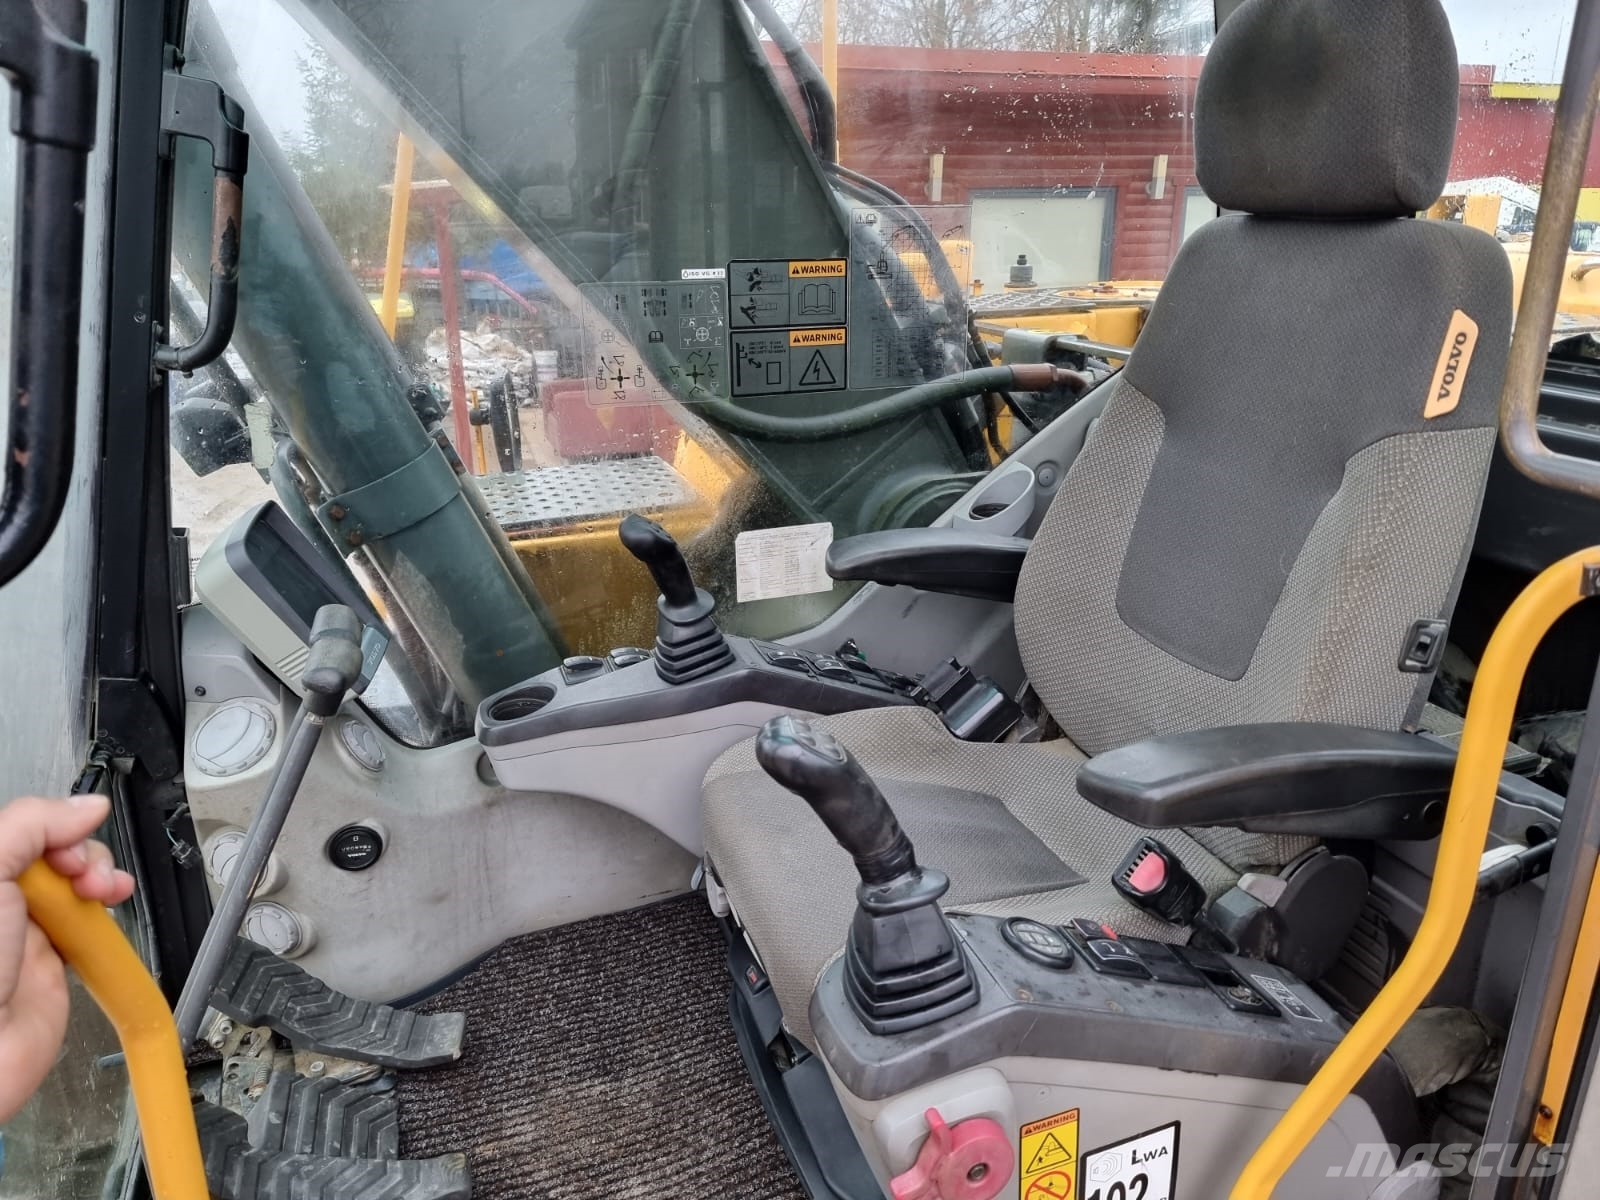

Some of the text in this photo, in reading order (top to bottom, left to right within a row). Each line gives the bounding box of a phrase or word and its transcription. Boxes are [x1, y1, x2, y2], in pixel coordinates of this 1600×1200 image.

[801, 265, 843, 274] WARNING
[801, 333, 843, 342] WARNING
[1436, 331, 1468, 402] VOLVO
[1032, 1112, 1077, 1132] WARNING
